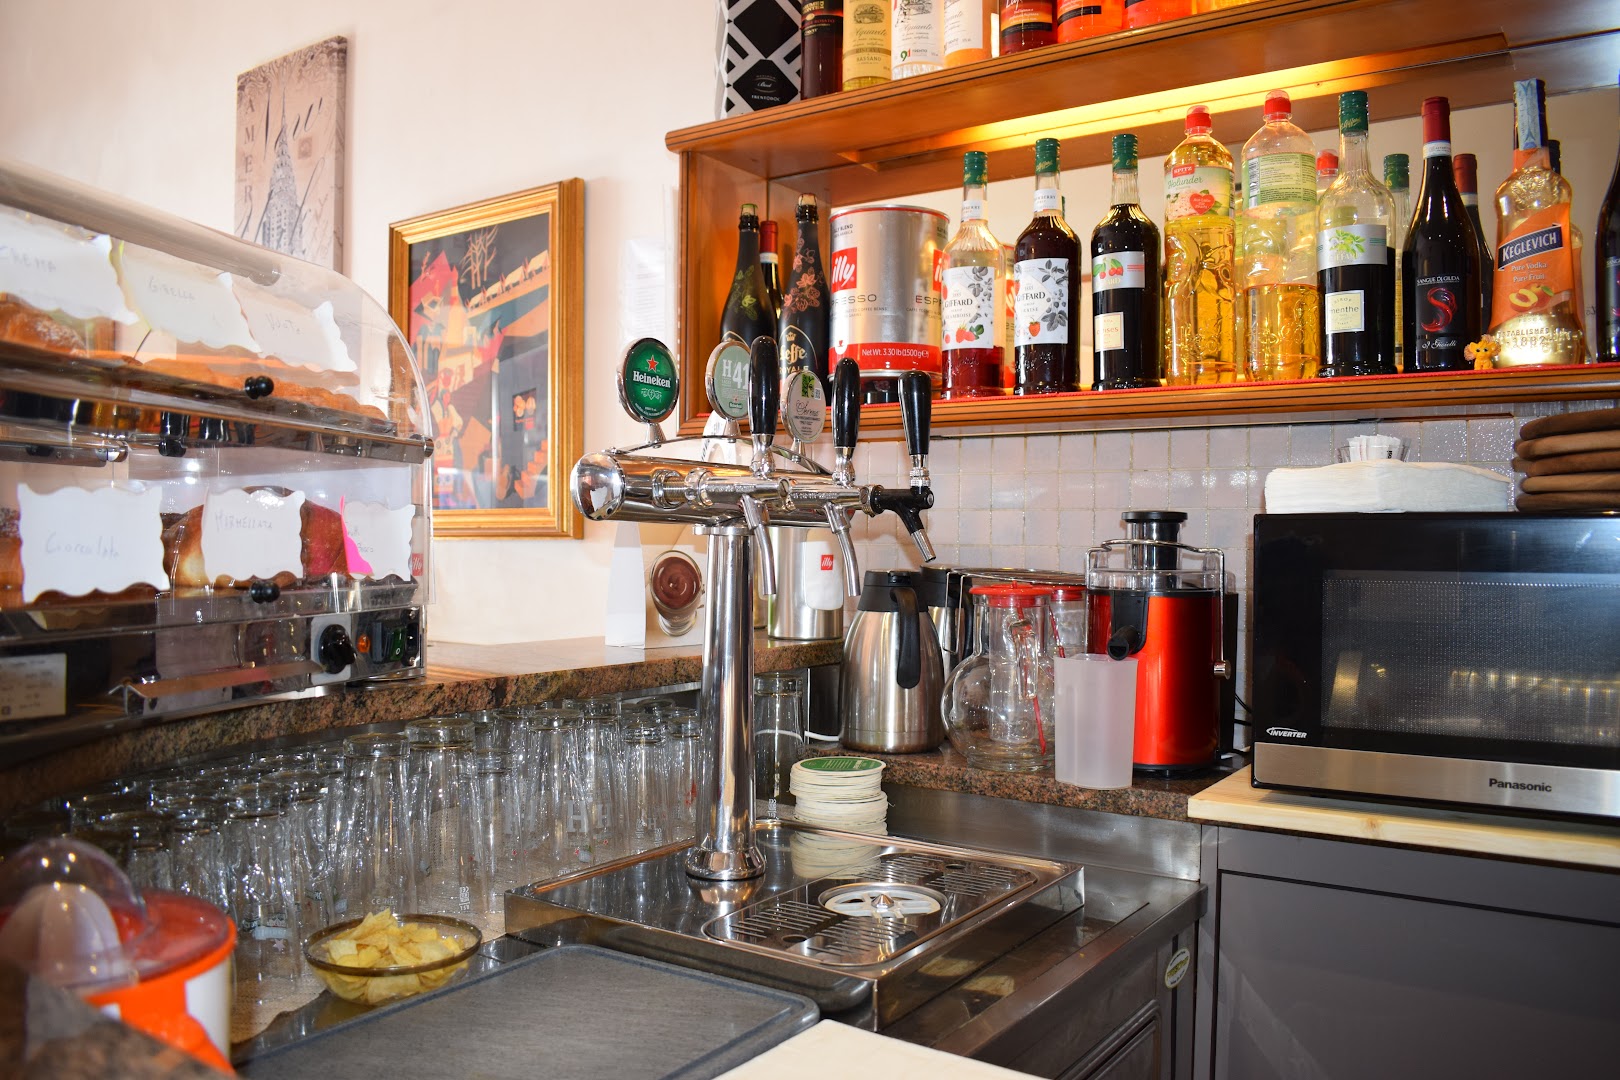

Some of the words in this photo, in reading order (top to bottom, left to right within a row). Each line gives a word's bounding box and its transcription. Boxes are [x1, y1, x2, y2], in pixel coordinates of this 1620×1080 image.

[1167, 175, 1204, 189] Holunder
[1502, 232, 1557, 262] KEGLEVICH
[832, 255, 855, 288] illy
[1511, 264, 1526, 272] Pure
[1526, 262, 1547, 270] Vodka
[1416, 276, 1437, 284] SANGUE
[1529, 273, 1545, 281] Fruit
[944, 298, 973, 308] GIFFARD
[861, 348, 872, 356] Net
[883, 348, 895, 356] 3.30
[632, 370, 671, 388] Heineken
[821, 556, 833, 569] illy
[1266, 727, 1308, 739] INVERTER
[1488, 777, 1553, 793] Panasonic
